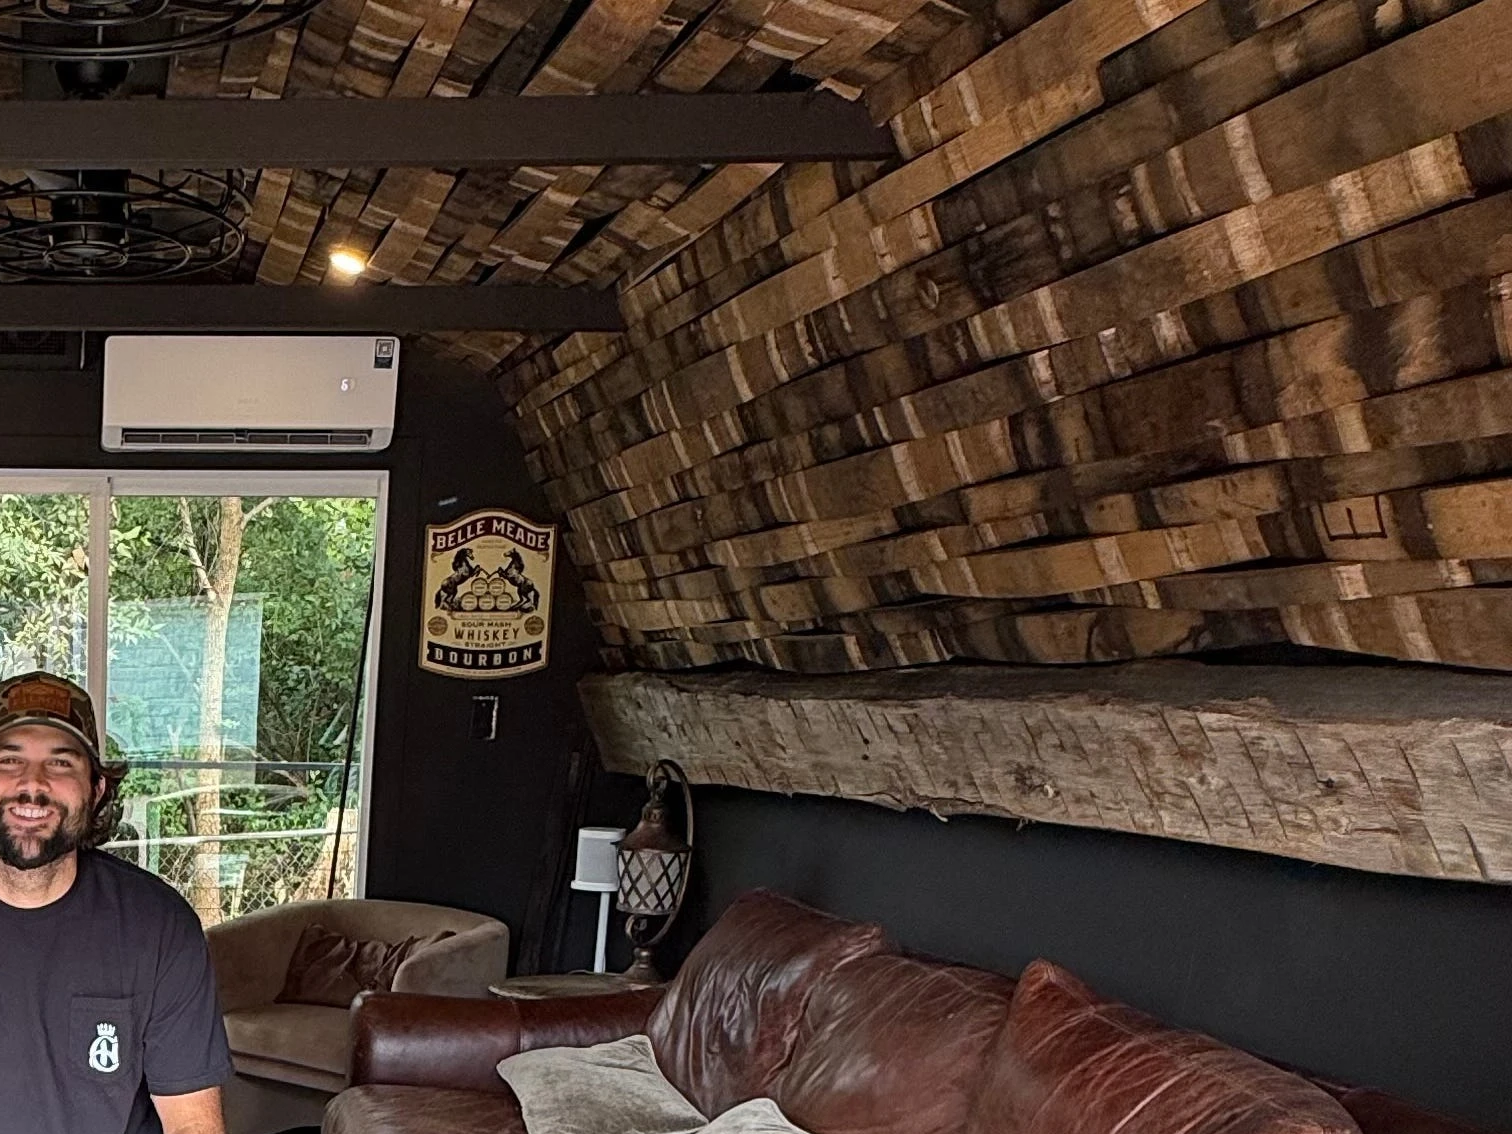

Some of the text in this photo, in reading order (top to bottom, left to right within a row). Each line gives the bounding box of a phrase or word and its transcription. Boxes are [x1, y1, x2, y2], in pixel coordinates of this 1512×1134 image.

[435, 519, 547, 549] BELLE MEADE
[454, 627, 519, 641] WHISKEY
[434, 647, 532, 667] BOURBON
